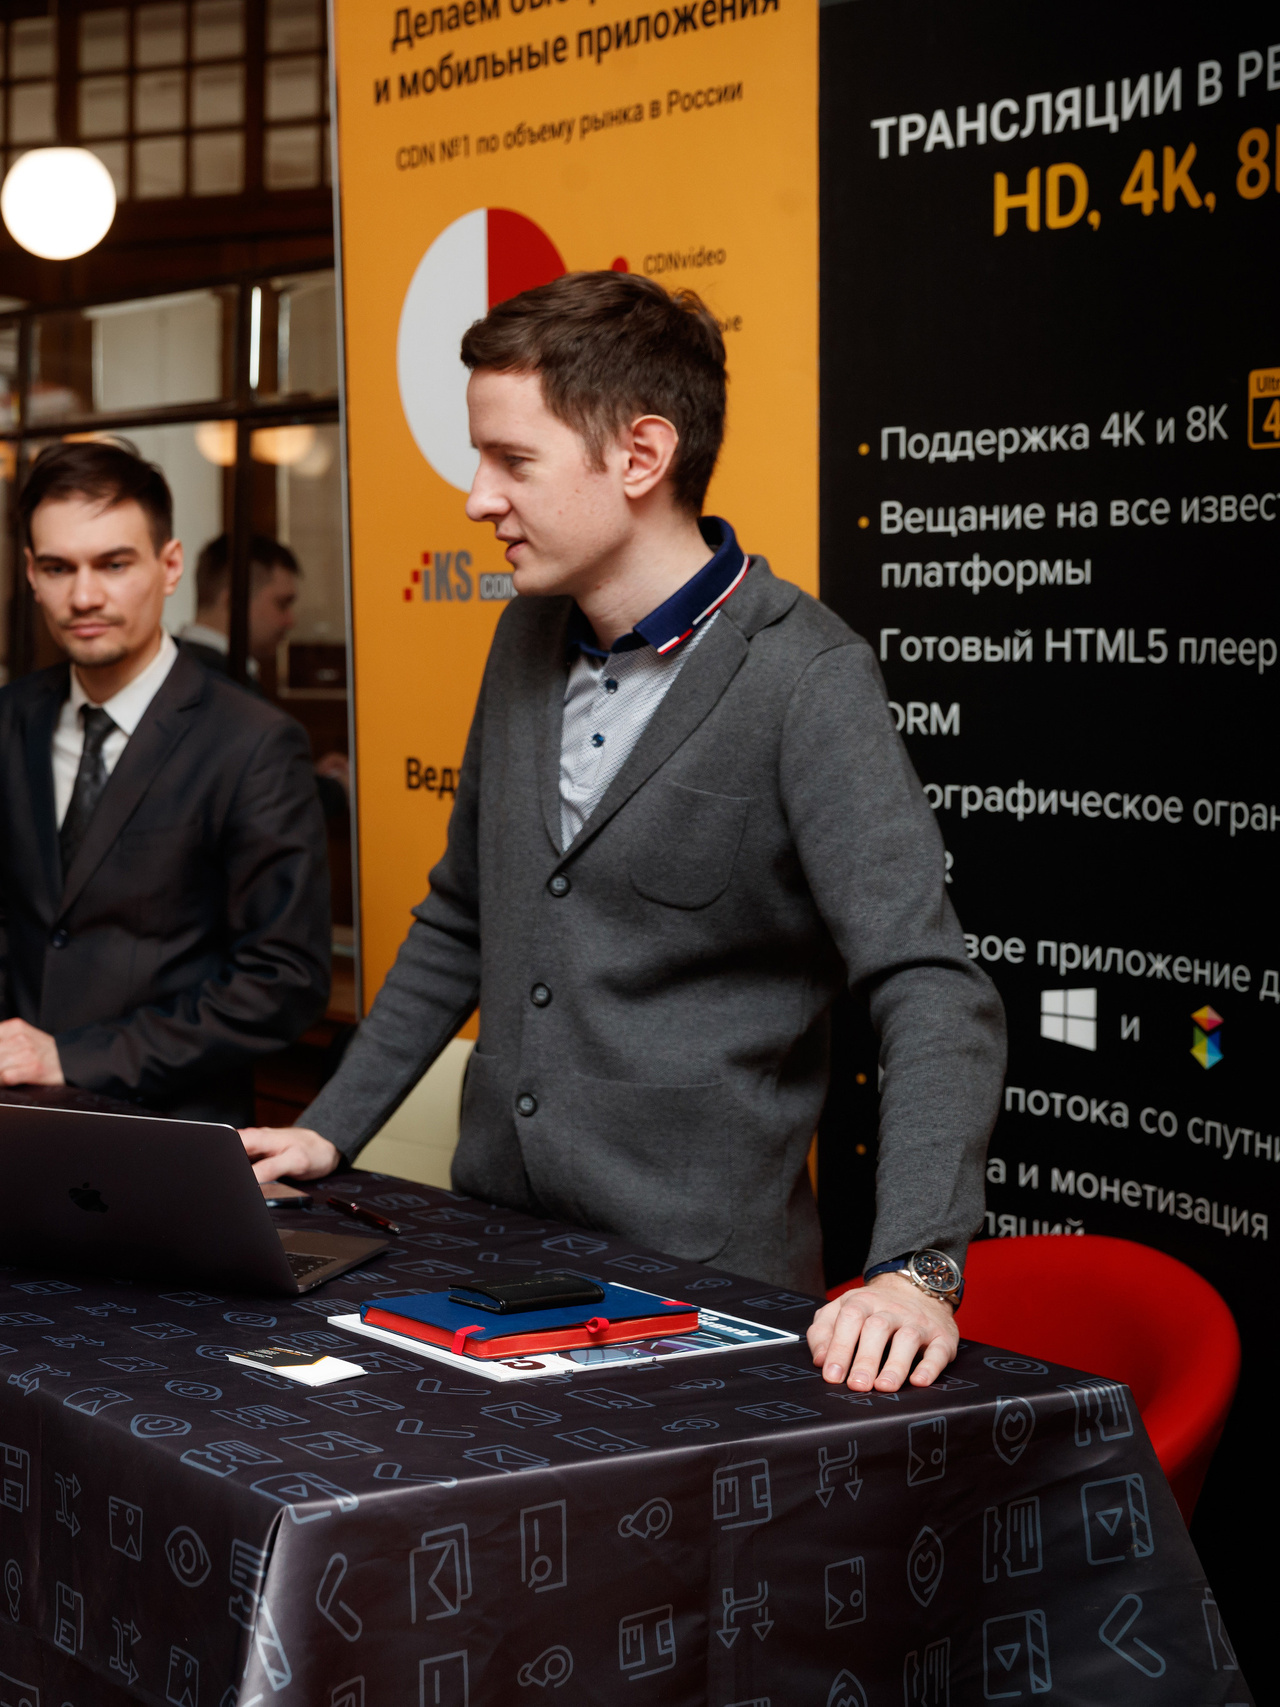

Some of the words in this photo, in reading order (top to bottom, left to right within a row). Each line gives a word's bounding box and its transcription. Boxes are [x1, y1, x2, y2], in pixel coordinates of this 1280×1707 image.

[391, 0, 500, 53] Делаем
[374, 77, 391, 105] и
[397, 34, 569, 100] мобильные
[396, 143, 435, 171] CDN
[438, 135, 471, 161] №1
[476, 133, 500, 155] по
[503, 118, 575, 152] объему
[579, 102, 645, 139] рынка
[648, 99, 662, 120] в
[666, 81, 744, 116] России
[870, 66, 1183, 160] ТРАНСЛЯЦИИ
[1197, 59, 1223, 107] В
[1237, 42, 1280, 98] РЕ
[993, 161, 1101, 238] HD,
[1120, 141, 1217, 217] 4K,
[643, 246, 727, 276] CDNvideo
[880, 423, 1090, 464] Поддержка
[1100, 410, 1146, 448] 4K
[1156, 416, 1175, 445] и
[1186, 403, 1230, 443] 8K
[880, 500, 1046, 538] Вещание
[1056, 500, 1098, 529] на
[1109, 497, 1171, 527] все
[1181, 492, 1280, 524] извес
[881, 553, 1092, 595] платформы
[880, 627, 1033, 663] Готовый
[1045, 627, 1169, 664] HTML5
[1178, 637, 1278, 675] плеер
[922, 779, 1184, 822] ографическое
[1192, 797, 1280, 838] огран
[1036, 939, 1252, 993] приложение
[1120, 1014, 1141, 1042] и
[1005, 1086, 1129, 1129] потока
[1139, 1106, 1179, 1138] со
[1018, 1162, 1039, 1189] и
[1050, 1167, 1270, 1242] монетизация
